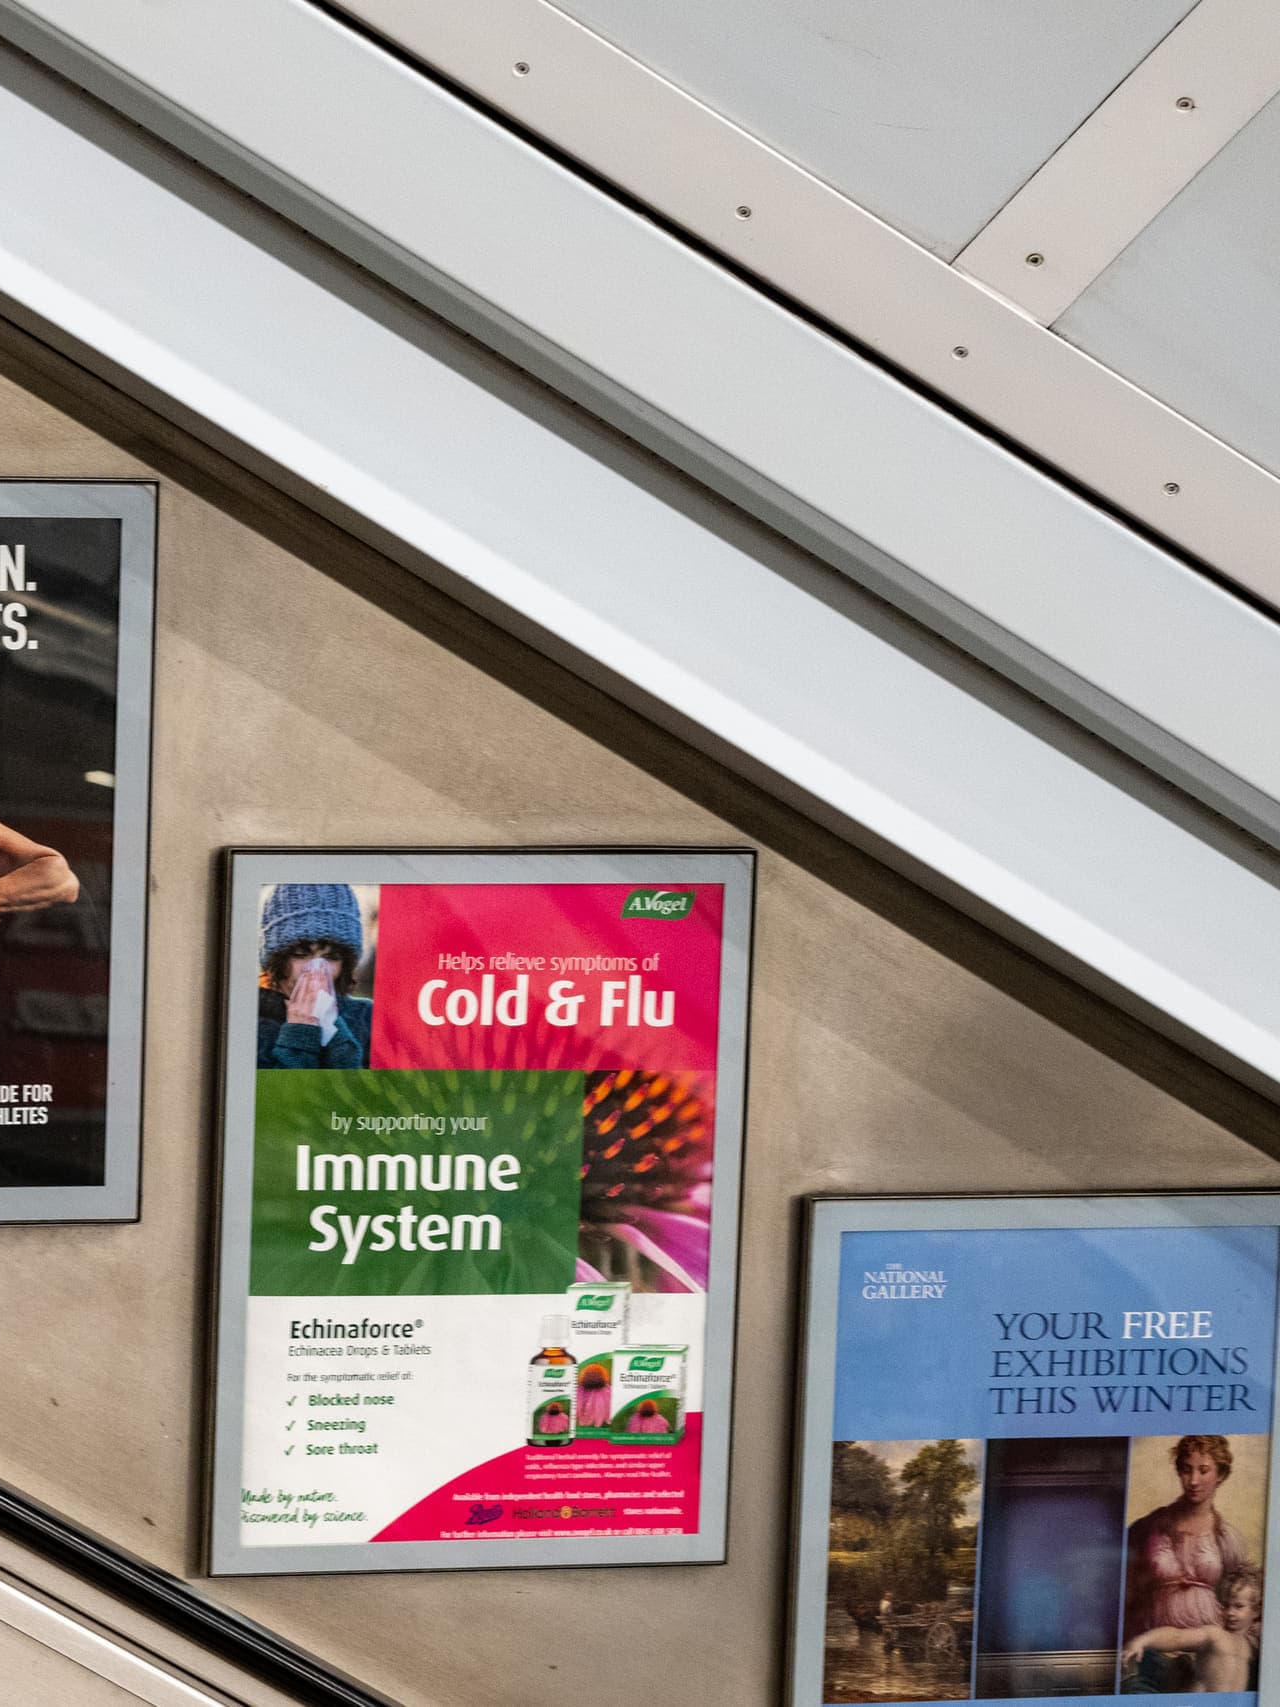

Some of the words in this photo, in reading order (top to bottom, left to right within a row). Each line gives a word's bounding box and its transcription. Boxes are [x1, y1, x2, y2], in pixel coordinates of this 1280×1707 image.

[628, 891, 688, 915] A.Vogel
[438, 953, 484, 972] Helps
[489, 953, 545, 971] relieve
[550, 954, 638, 973] symptoms
[642, 953, 660, 972] of
[418, 974, 528, 1026] Cold
[545, 980, 585, 1027] &
[600, 975, 675, 1027] Flu
[23, 1084, 53, 1102] FOR
[331, 1112, 351, 1132] by
[356, 1113, 444, 1135] supporting
[450, 1114, 488, 1133] your
[295, 1145, 520, 1191] Immune
[309, 1205, 502, 1265] System
[863, 1271, 949, 1283] NATIONAL
[862, 1285, 948, 1299] GALLERY
[993, 1312, 1111, 1341] YOUR
[1122, 1310, 1214, 1340] FREE
[288, 1345, 343, 1357] Echinacea
[346, 1345, 378, 1359] Drops
[381, 1345, 390, 1356] &
[393, 1344, 432, 1356] Tablets
[989, 1346, 1249, 1379] EXHIBITIONS
[287, 1373, 301, 1382] For
[303, 1372, 317, 1382] the
[319, 1372, 375, 1384] symptomatic
[308, 1393, 360, 1406] Blocked
[363, 1394, 395, 1405] nose
[989, 1386, 1078, 1415] THIS
[1091, 1384, 1258, 1414] WINTER
[307, 1418, 366, 1433] Sneezing
[306, 1443, 334, 1456] Sore
[338, 1442, 379, 1455] throat
[277, 1489, 293, 1509] by
[302, 1508, 319, 1529] by
